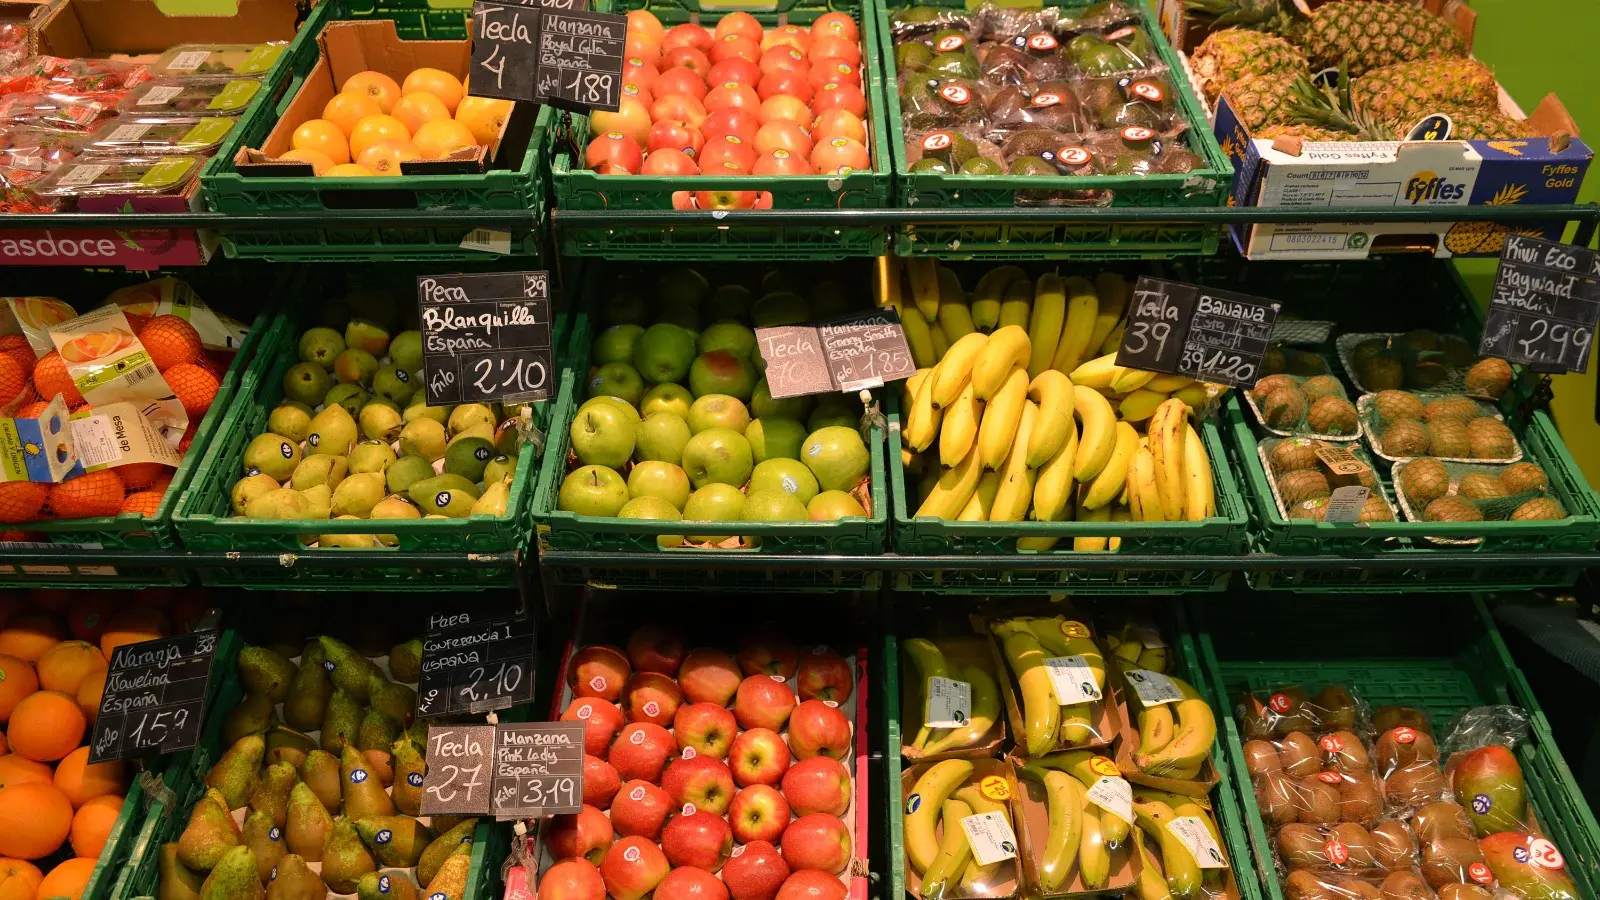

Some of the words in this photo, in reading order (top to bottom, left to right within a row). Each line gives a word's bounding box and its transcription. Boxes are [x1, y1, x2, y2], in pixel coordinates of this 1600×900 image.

[474, 7, 532, 44] Tecla
[547, 15, 612, 38] Manzana
[542, 36, 574, 56] Royal
[480, 44, 505, 89] 4
[542, 54, 592, 72] España
[566, 72, 612, 104] 1,89
[1541, 164, 1578, 176] Fyffes
[1545, 178, 1574, 188] Gold
[1506, 236, 1542, 262] Kiwi
[420, 278, 470, 302] Pera
[524, 280, 547, 298] 29
[1134, 290, 1179, 321] Tecla
[423, 306, 536, 336] Blanquilla
[822, 316, 892, 336] Manzana
[427, 332, 492, 358] España
[762, 332, 815, 358] Tecla
[829, 345, 876, 362] España
[1124, 322, 1171, 362] 39
[473, 358, 546, 394] 2'10
[862, 352, 909, 378] 1,85
[113, 416, 125, 440] Mesa
[120, 440, 130, 452] de
[112, 644, 182, 670] Naranja
[105, 669, 171, 694] Navelina
[102, 692, 159, 716] España
[1270, 696, 1287, 710] 1€
[431, 731, 484, 758] Tecla
[503, 731, 571, 746] Manzana
[1326, 738, 1342, 747] 1€
[528, 747, 558, 764] Lady
[426, 764, 483, 802] 27
[498, 763, 550, 781] España
[523, 777, 575, 806] 3,19
[1327, 844, 1345, 860] 1€
